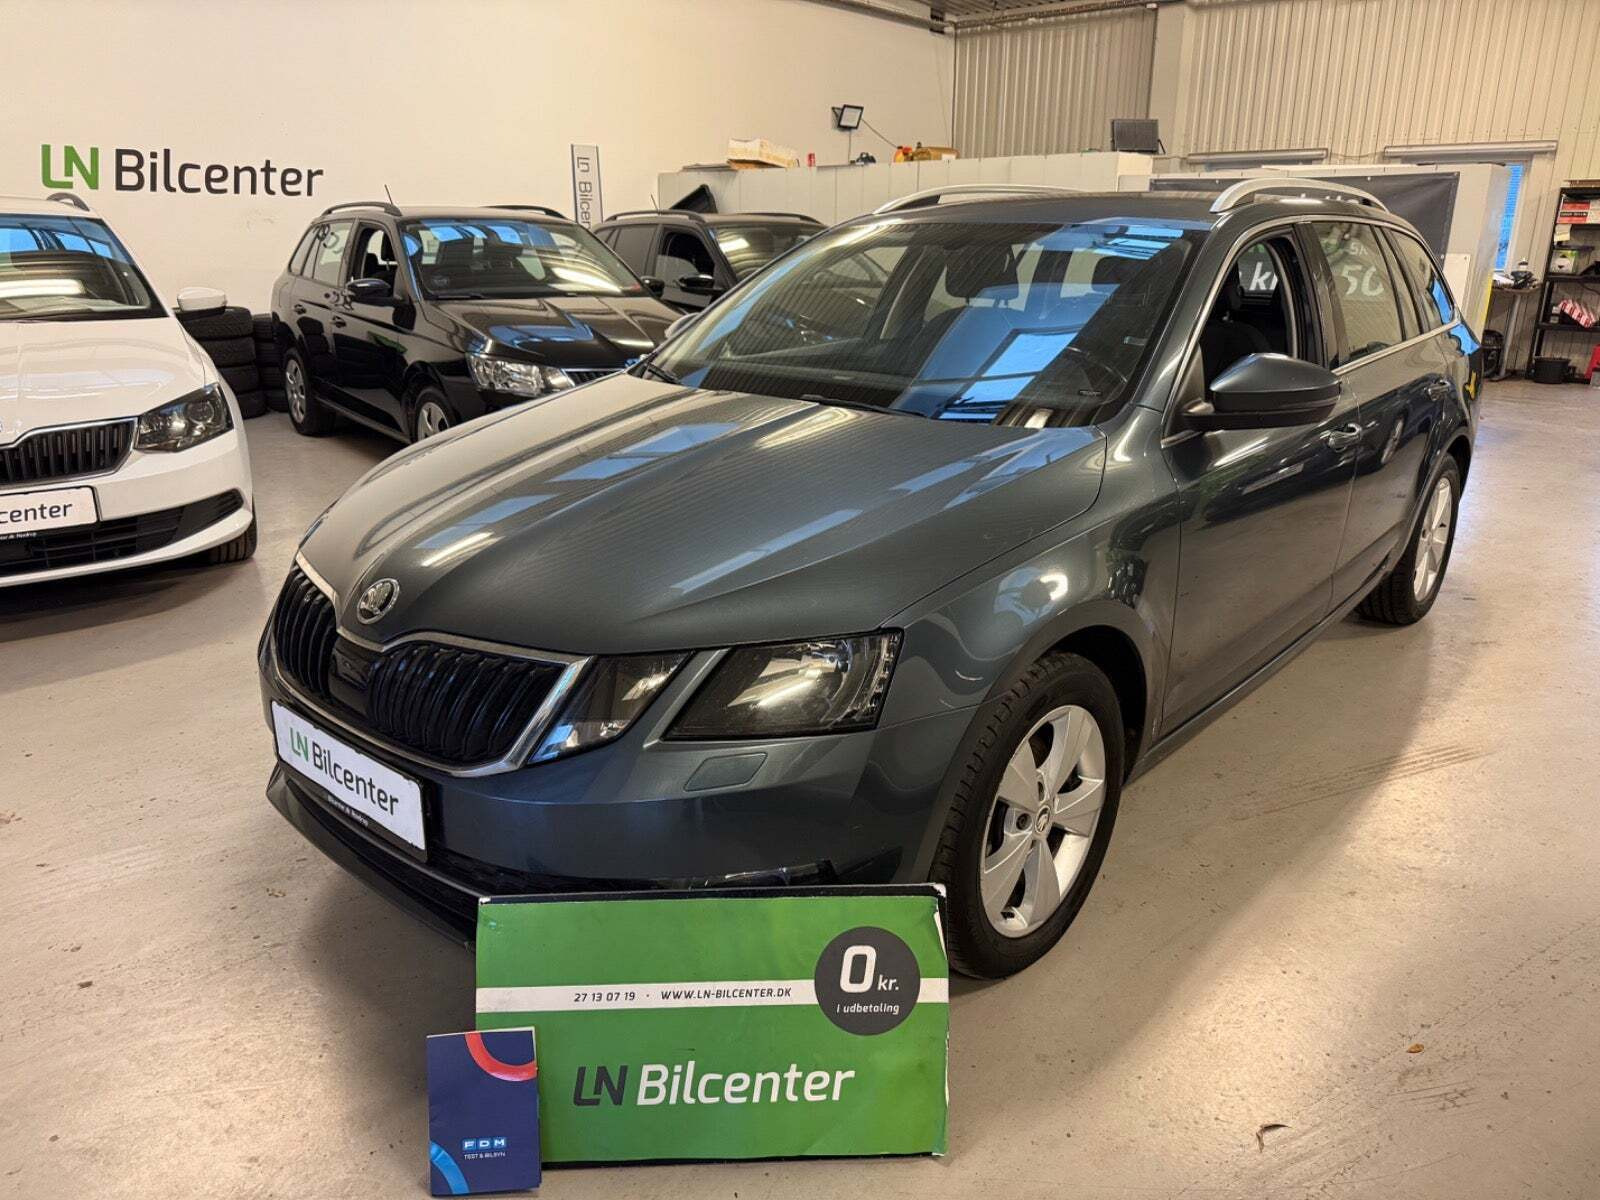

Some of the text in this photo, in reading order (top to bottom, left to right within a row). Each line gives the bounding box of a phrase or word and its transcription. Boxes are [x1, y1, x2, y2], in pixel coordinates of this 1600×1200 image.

[41, 143, 324, 196] LN Bilcenter
[290, 727, 309, 762] LN
[312, 741, 399, 815] Bilcenter
[839, 943, 900, 994] 0 kr.
[574, 988, 792, 1003] 27 13 07 19 WWW.LN-BILCENTER.DK
[842, 1001, 900, 1016] udbetaling
[572, 1060, 855, 1108] LN Bilcenter
[463, 1138, 505, 1148] FDM
